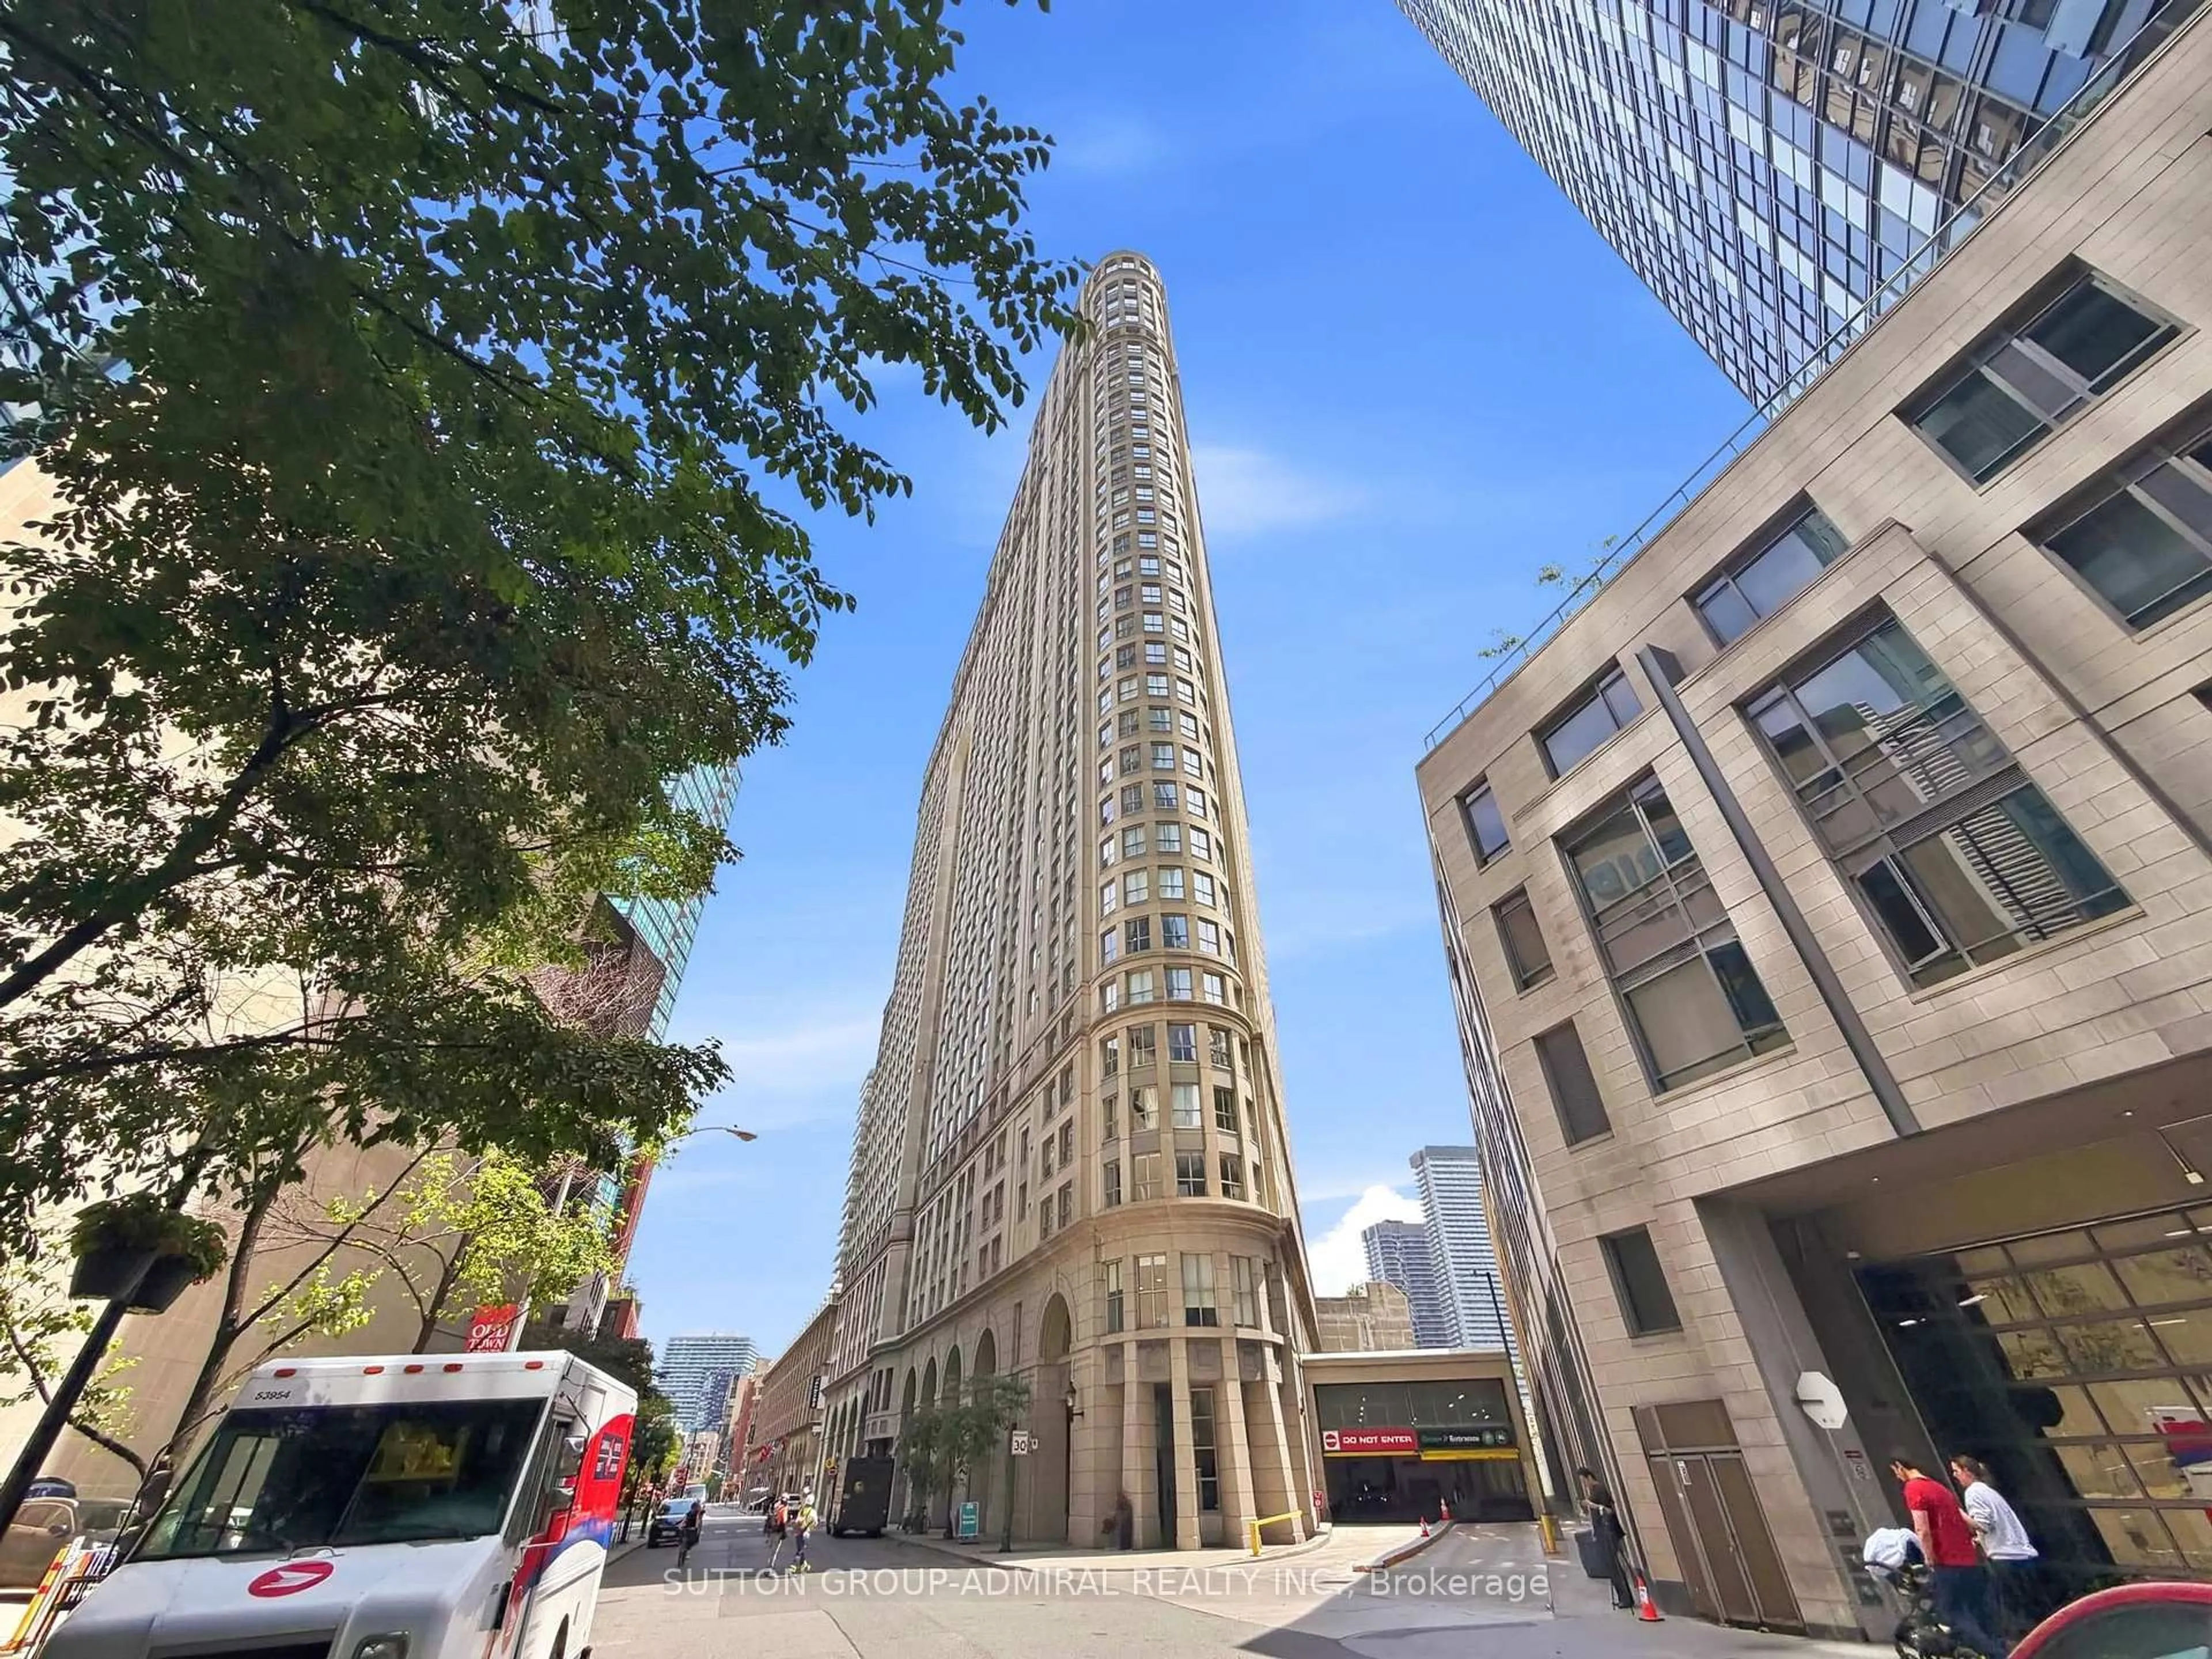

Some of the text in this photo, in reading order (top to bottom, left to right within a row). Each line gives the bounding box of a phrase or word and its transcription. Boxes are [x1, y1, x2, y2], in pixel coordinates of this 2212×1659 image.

[473, 1324, 509, 1338] OLD
[1342, 1436, 1357, 1444] DO
[1359, 1435, 1378, 1444] NOT
[1380, 1435, 1412, 1444] ENTER
[1014, 1440, 1027, 1451] 30
